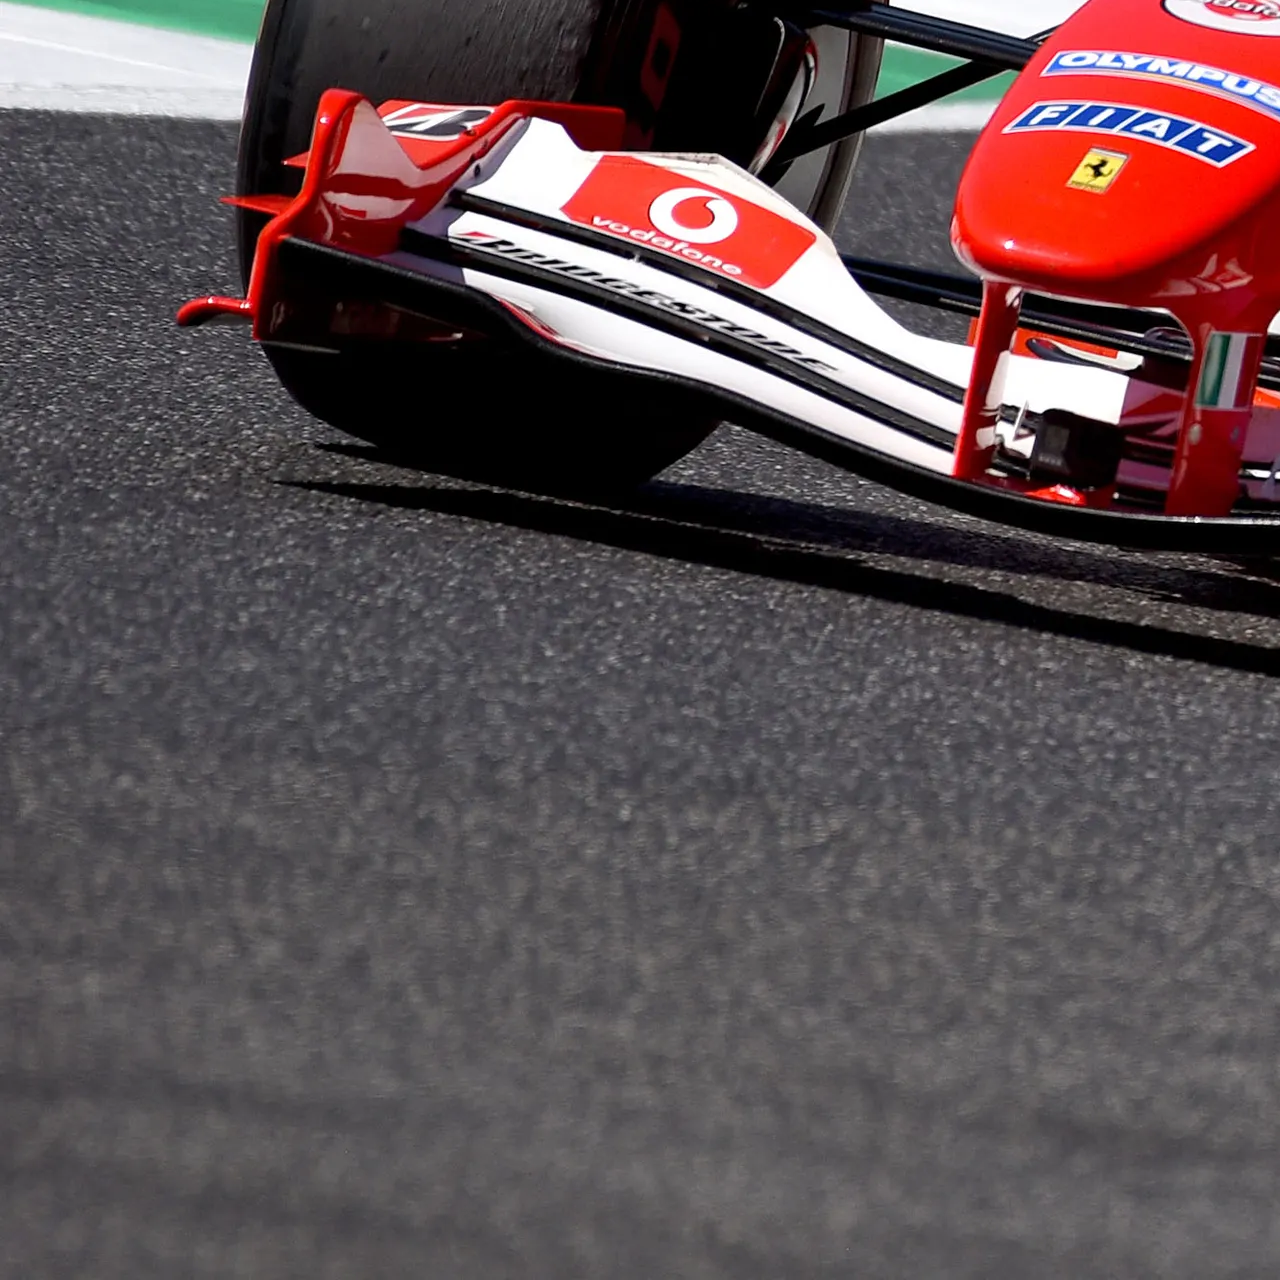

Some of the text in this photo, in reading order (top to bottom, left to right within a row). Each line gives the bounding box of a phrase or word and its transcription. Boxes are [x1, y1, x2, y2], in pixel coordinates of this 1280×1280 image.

[1028, 104, 1234, 160] FIAT
[592, 215, 743, 275] vodafone
[451, 231, 840, 372] BRIDGESTONE
